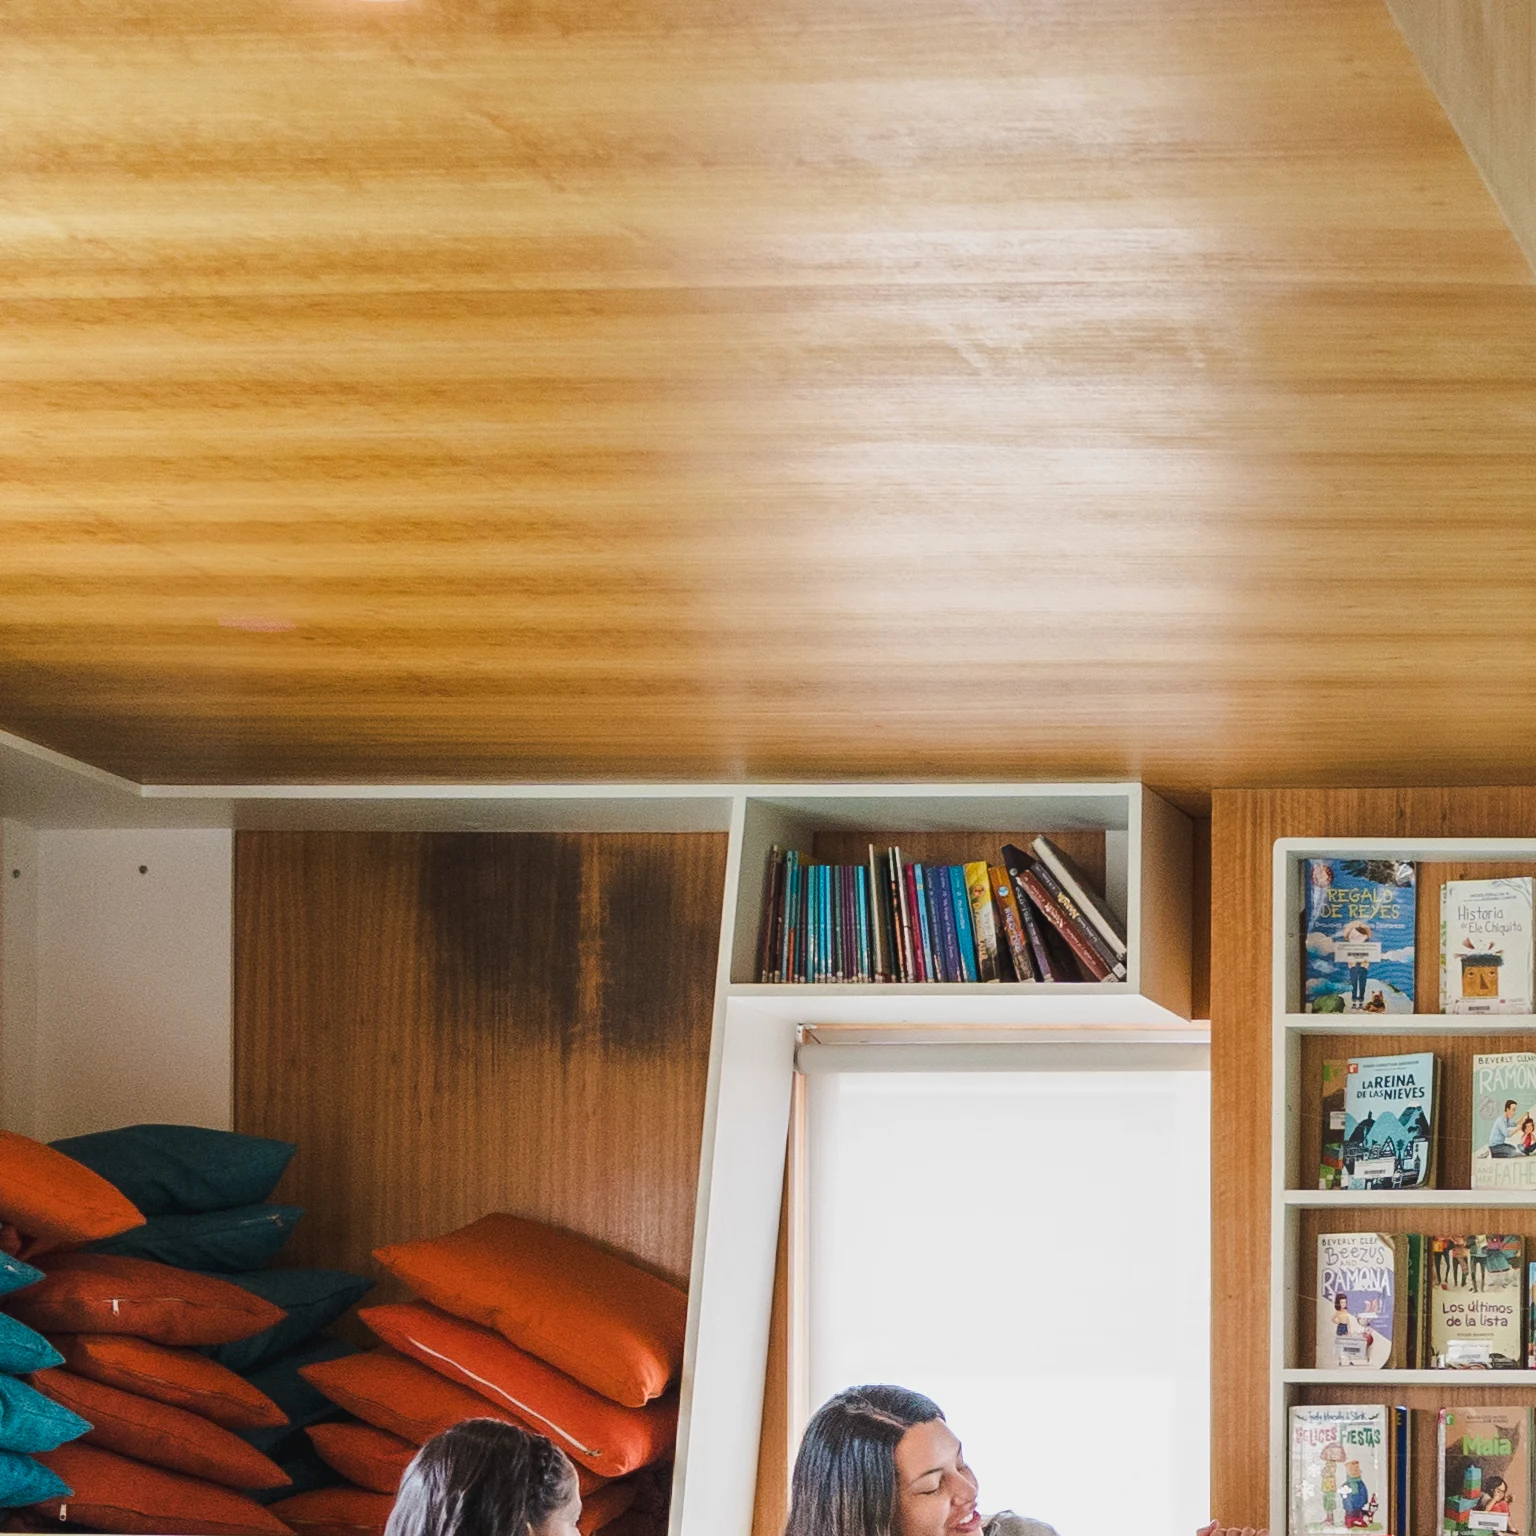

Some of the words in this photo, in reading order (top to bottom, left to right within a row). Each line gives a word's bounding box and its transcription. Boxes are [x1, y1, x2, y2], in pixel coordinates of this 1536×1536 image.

[1327, 888, 1393, 902] REGALO
[1321, 905, 1342, 918] DE
[1350, 905, 1400, 919] REYES
[1458, 906, 1503, 921] Historia
[1485, 921, 1522, 936] Chiquita
[1478, 1056, 1513, 1065] BEVERLY
[1362, 1081, 1373, 1090] LA
[1374, 1074, 1416, 1089] REINA
[1369, 1090, 1384, 1098] LAS
[1384, 1087, 1425, 1100] NIEVES
[1322, 1238, 1356, 1246] BEVERLY
[1322, 1267, 1391, 1301] RAMONA
[1442, 1302, 1465, 1314] Los
[1468, 1300, 1514, 1314] últimos
[1446, 1315, 1462, 1327] de
[1465, 1314, 1477, 1326] la
[1480, 1313, 1508, 1327] lista
[1295, 1426, 1338, 1446] FELICES
[1340, 1427, 1381, 1448] FIESTAS
[1462, 1434, 1512, 1456] Maia
